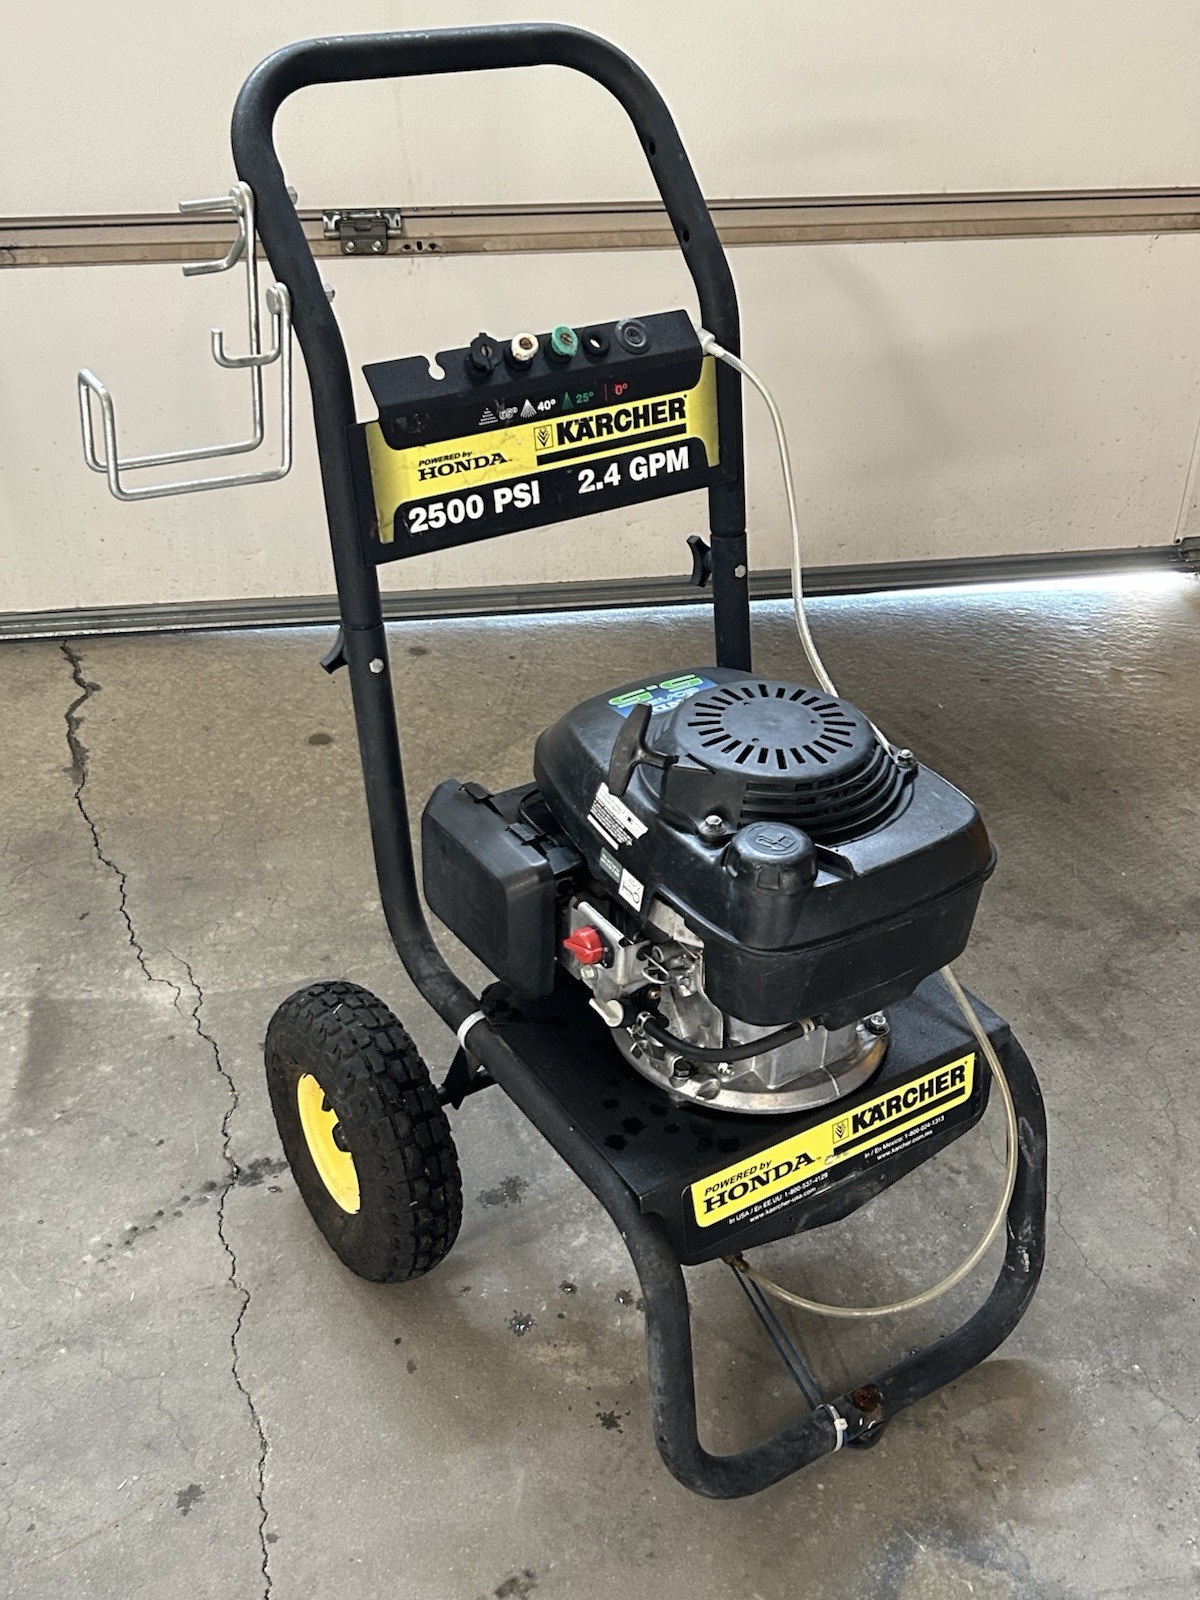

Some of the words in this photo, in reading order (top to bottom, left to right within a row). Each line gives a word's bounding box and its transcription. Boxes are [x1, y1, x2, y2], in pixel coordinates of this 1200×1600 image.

[556, 397, 686, 446] KÄRCHER
[418, 452, 461, 467] POWERED
[462, 451, 473, 459] by
[418, 452, 508, 481] HONDA
[408, 494, 484, 534] 2500
[493, 480, 540, 514] PSI
[577, 462, 621, 494] 2.4
[629, 446, 689, 481] GPM
[852, 1064, 966, 1135] KÄRCHER
[703, 1152, 815, 1214] HONDA
[704, 1165, 757, 1196] POWERED
[759, 1160, 772, 1171] by
[736, 1210, 750, 1221] USA
